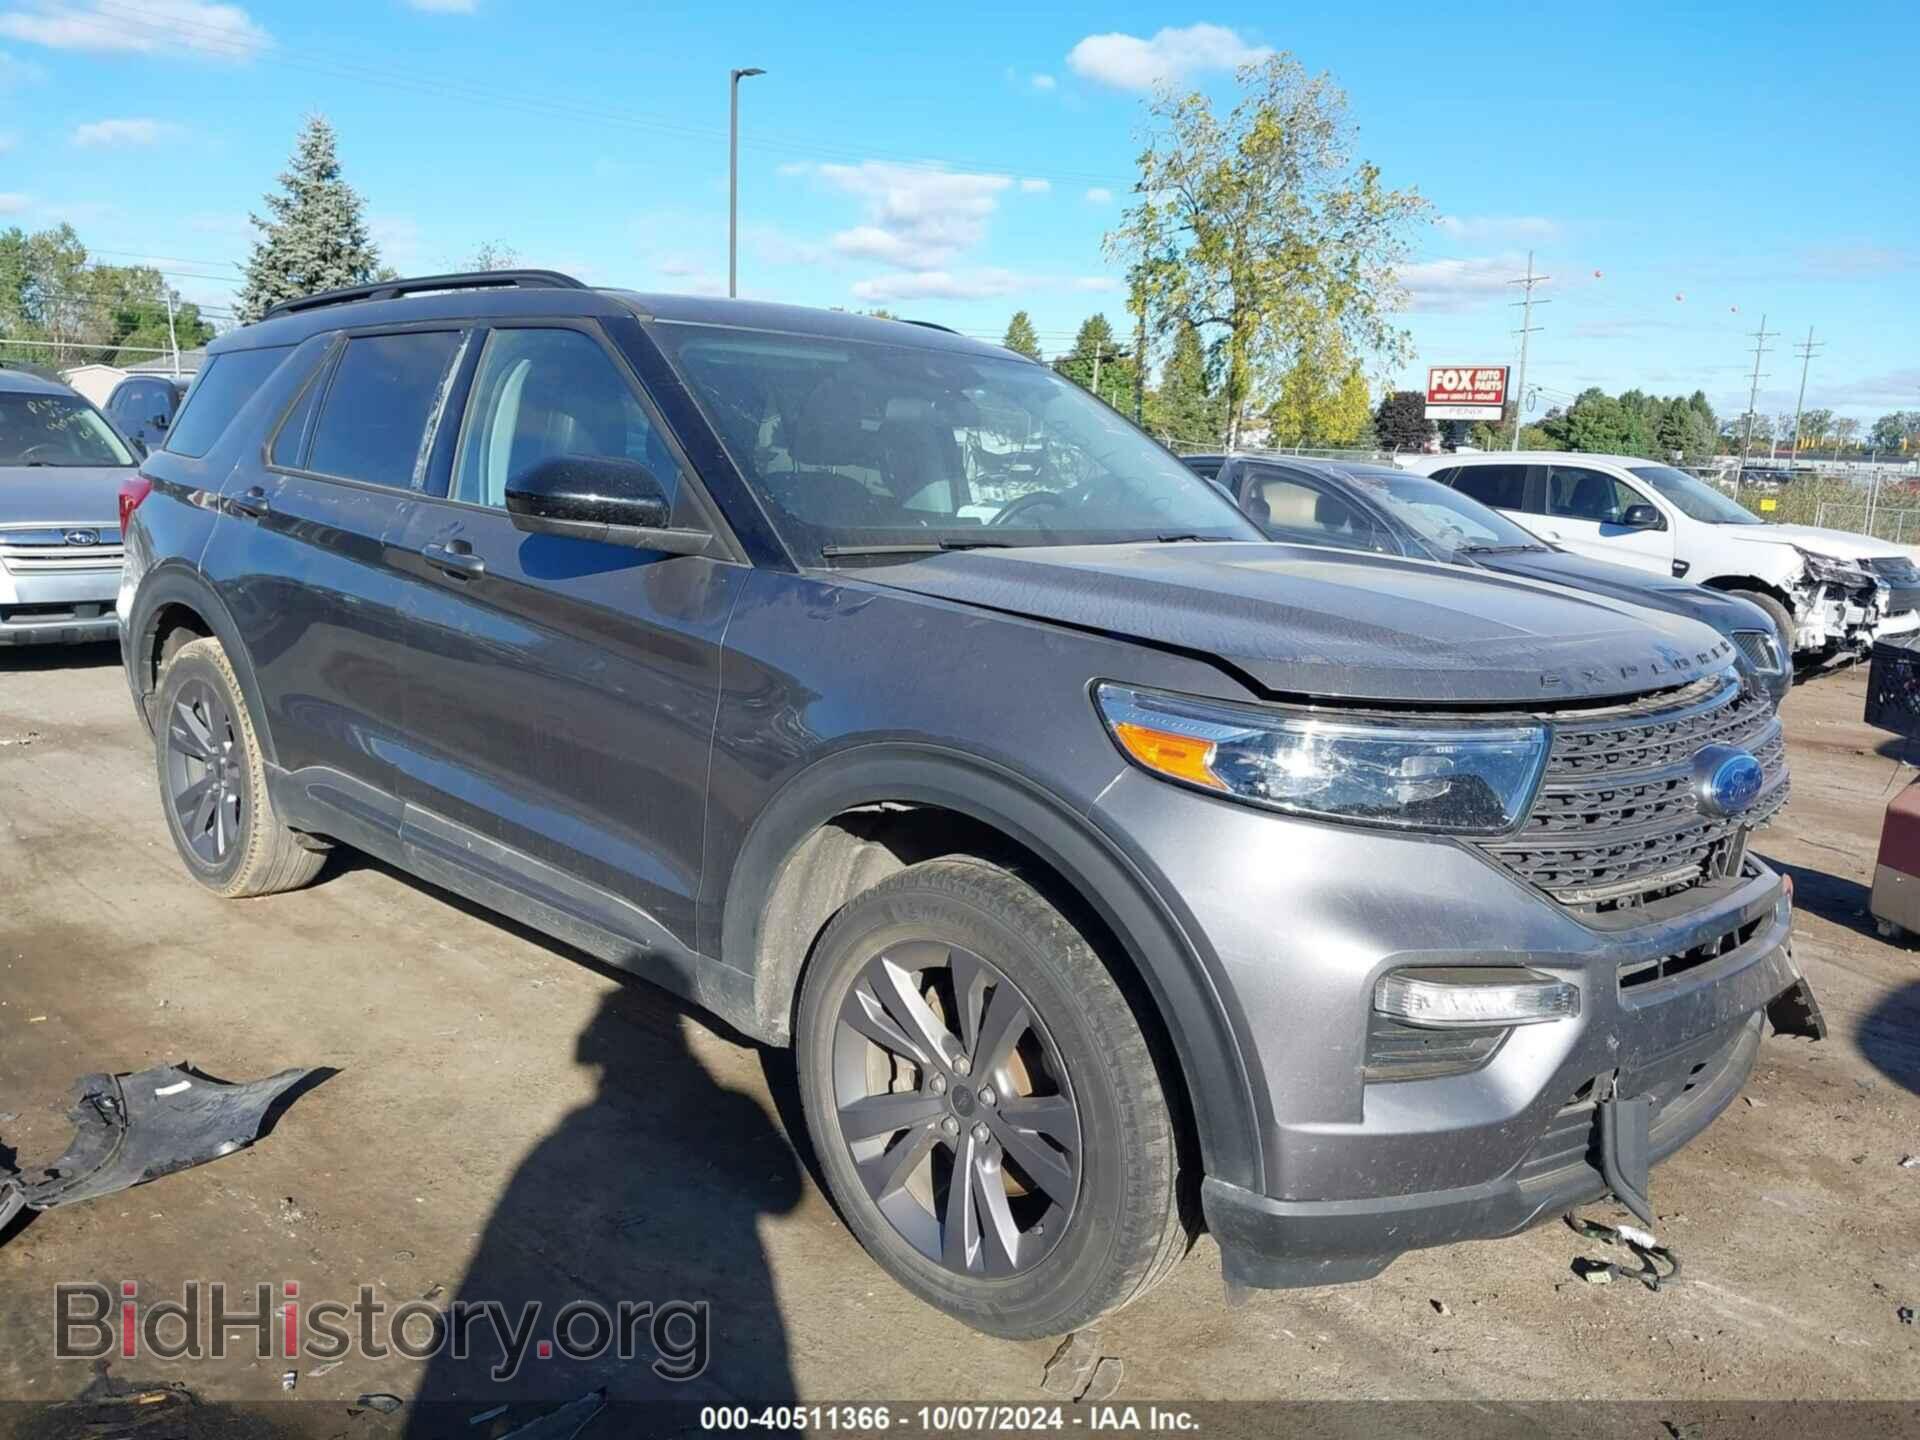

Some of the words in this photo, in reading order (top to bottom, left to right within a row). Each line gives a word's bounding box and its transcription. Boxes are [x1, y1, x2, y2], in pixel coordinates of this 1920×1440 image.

[1430, 370, 1474, 391] FOX
[1475, 370, 1500, 381] AUTO
[1474, 380, 1502, 391] PARTS
